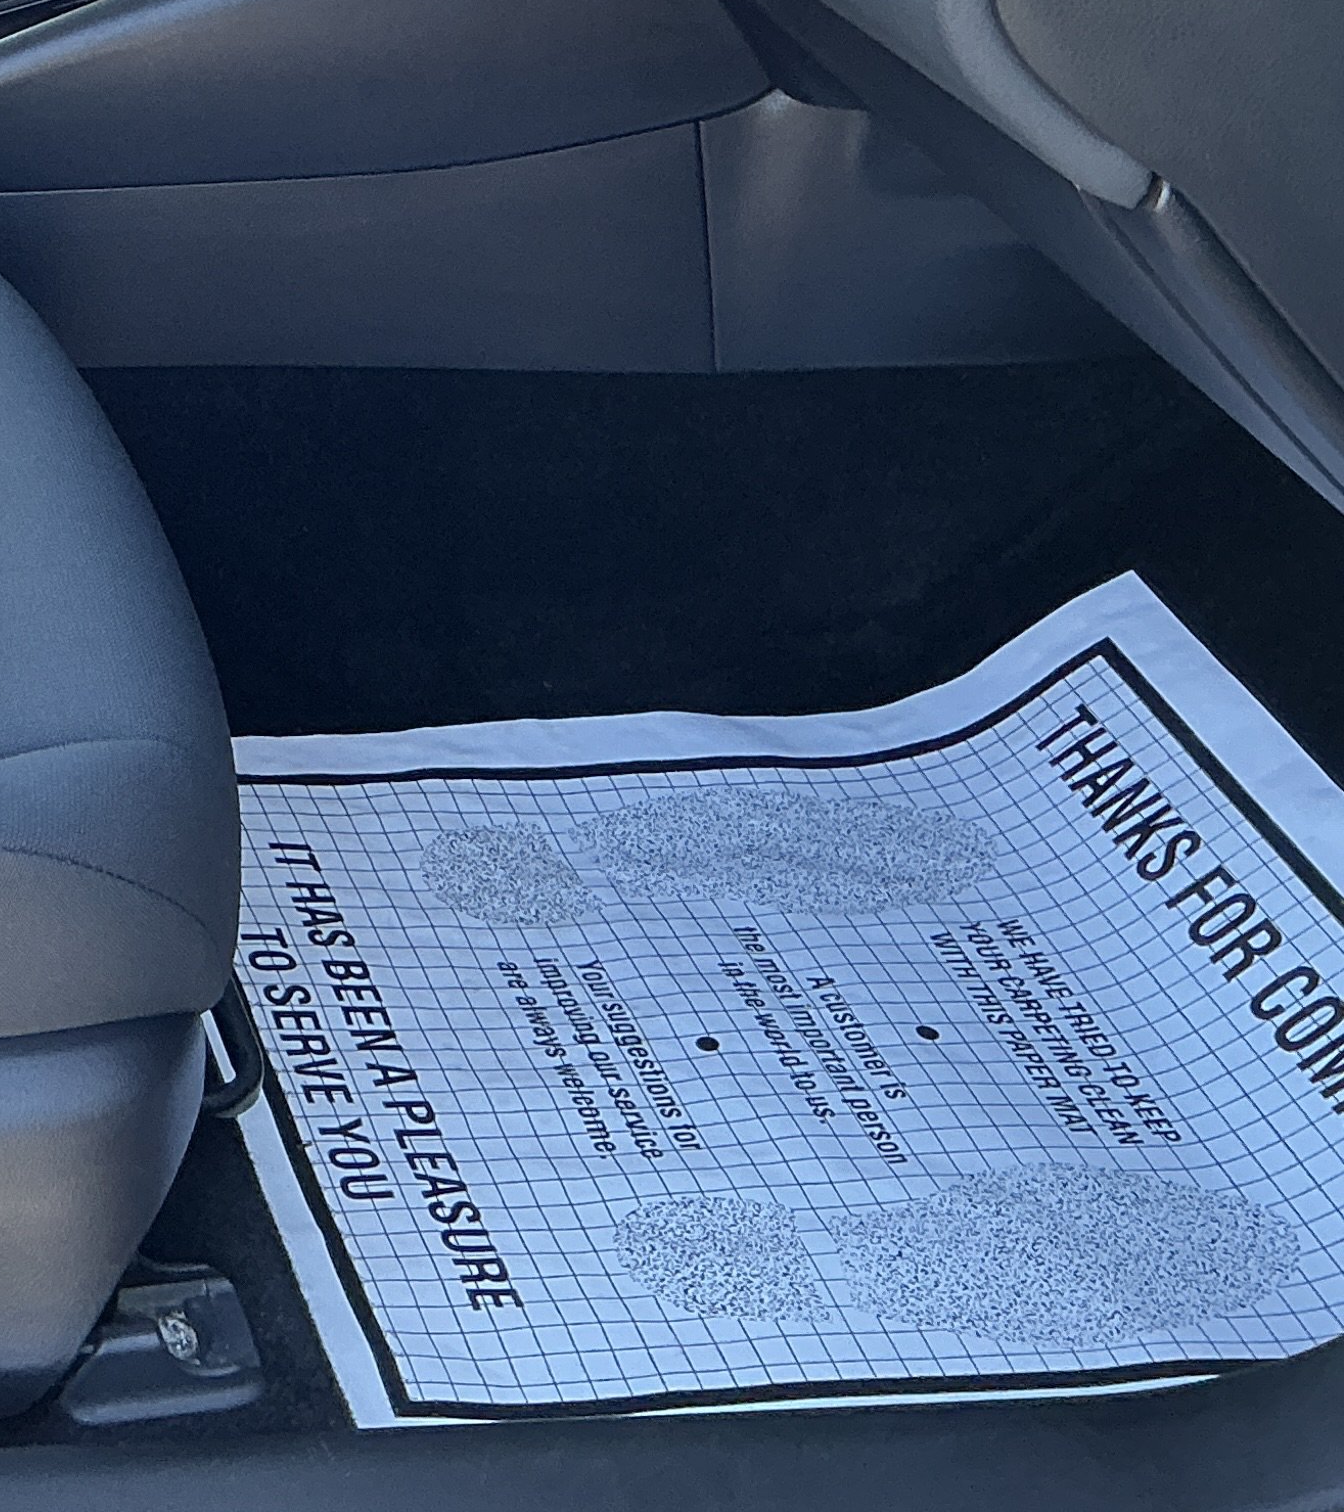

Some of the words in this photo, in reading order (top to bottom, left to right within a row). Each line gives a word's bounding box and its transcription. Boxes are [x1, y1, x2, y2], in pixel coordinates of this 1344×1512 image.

[268, 841, 321, 872] IT
[1036, 703, 1202, 882] THANKS
[1165, 865, 1283, 983] FOR
[1250, 965, 1344, 1115] COM
[241, 926, 297, 973] TO
[285, 880, 355, 949] HAS
[321, 959, 402, 1052] BEEN
[497, 961, 528, 989] are
[515, 996, 567, 1058] always
[806, 975, 835, 990] A
[820, 993, 892, 1077] customer
[929, 932, 981, 978] WITH
[967, 984, 1014, 1025] THIS
[999, 1029, 1061, 1089] PAPER
[1046, 1094, 1098, 1136] MAT
[960, 921, 1012, 971] YOUR
[998, 976, 1092, 1078] CARPETING
[1078, 1084, 1144, 1145] CLEAN
[997, 919, 1036, 949] WE
[1019, 951, 1075, 999] HAVE
[1059, 1001, 1117, 1058] TRIED
[1103, 1061, 1140, 1088] TO
[1124, 1093, 1182, 1143] KEEP
[263, 984, 356, 1105] SERVE
[365, 1062, 419, 1087] A
[533, 957, 601, 1045] improving
[588, 1051, 623, 1081] our
[608, 1088, 664, 1160] service
[576, 958, 616, 999] Your
[602, 1003, 683, 1119] suggestions
[668, 1124, 703, 1151] for
[718, 961, 745, 978] in
[733, 981, 766, 1008] the
[754, 1013, 808, 1067] world
[790, 1071, 817, 1090] to
[804, 1096, 836, 1124] us.
[733, 926, 766, 953] the
[754, 958, 802, 1001] most
[785, 1004, 866, 1092] important
[841, 1097, 908, 1165] person
[880, 1082, 906, 1100] is
[318, 1118, 396, 1201] YOU
[383, 1100, 524, 1312] PLEASURE
